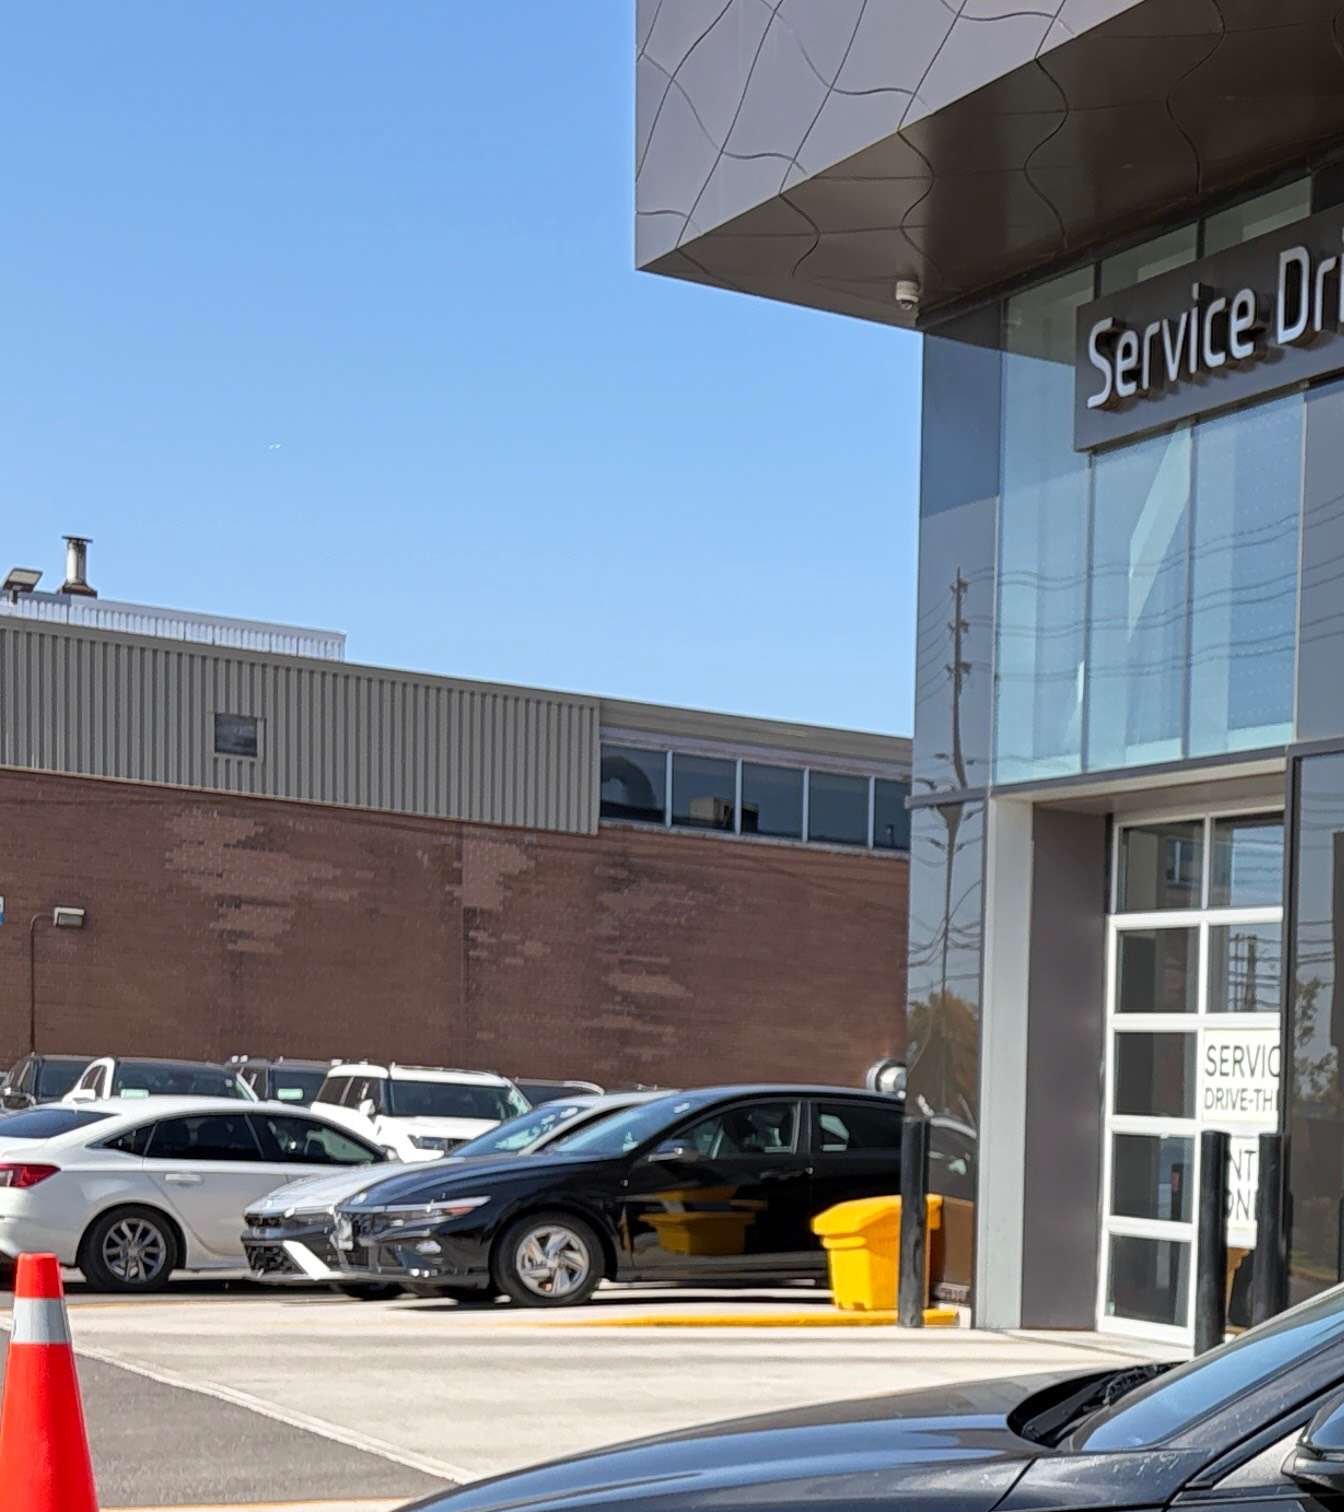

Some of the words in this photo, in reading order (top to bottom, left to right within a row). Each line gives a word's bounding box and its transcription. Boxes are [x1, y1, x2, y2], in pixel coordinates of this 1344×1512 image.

[1086, 282, 1257, 409] Service
[1204, 1043, 1282, 1079] SERVIC
[1203, 1086, 1280, 1112] DRIVE-TH
